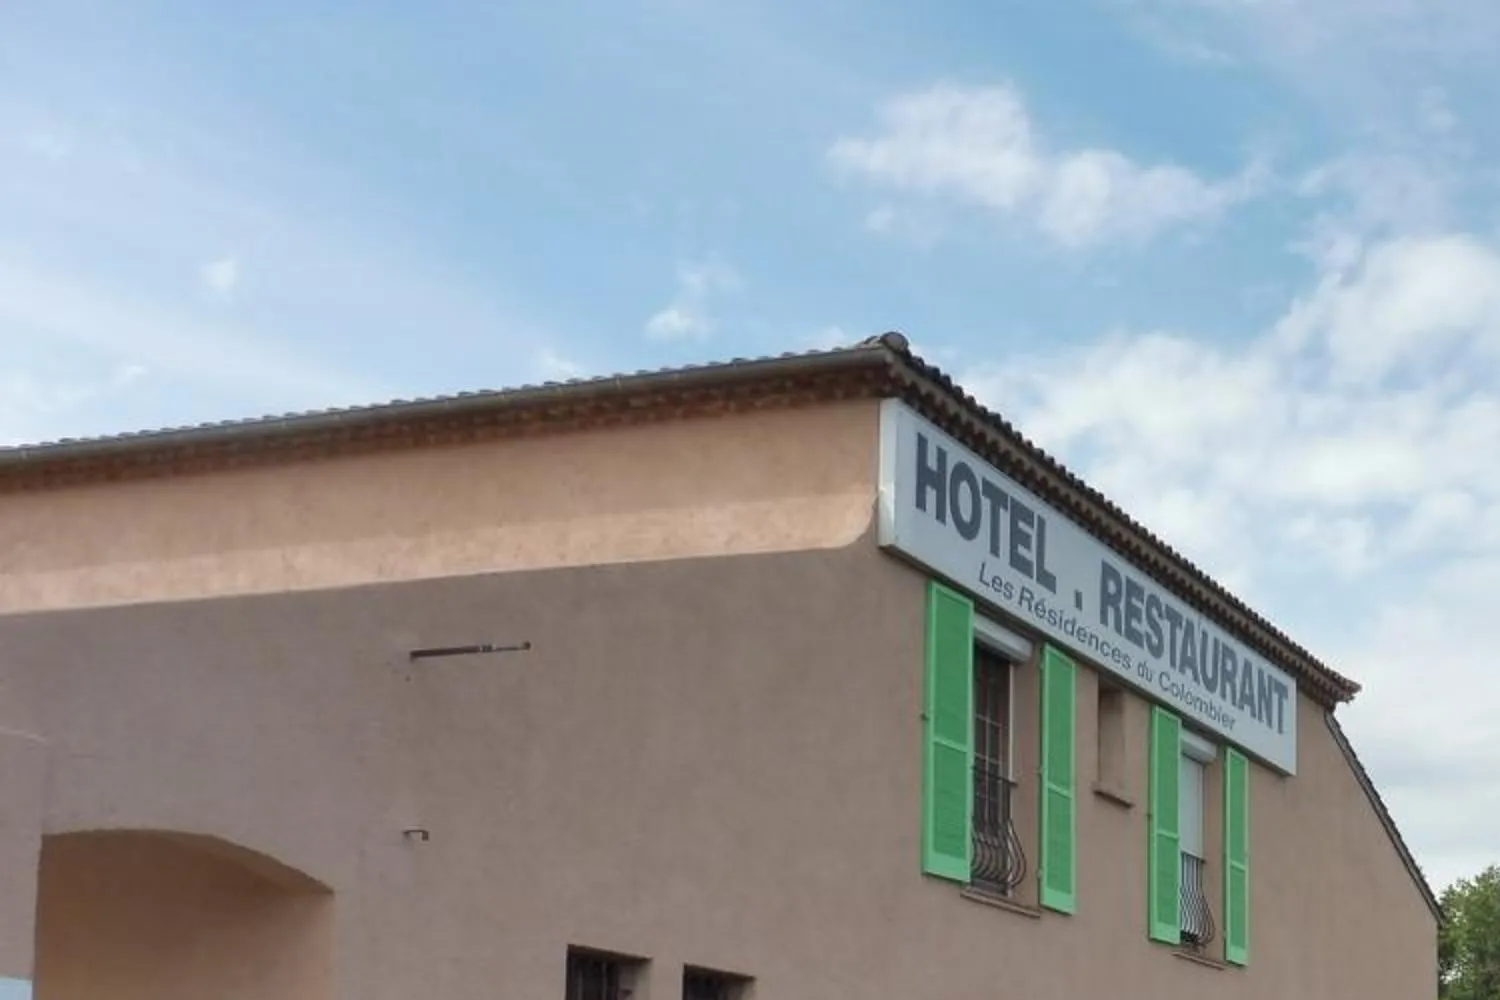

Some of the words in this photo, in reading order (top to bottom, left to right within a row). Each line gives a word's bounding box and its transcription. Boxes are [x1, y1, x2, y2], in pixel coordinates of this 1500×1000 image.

[915, 433, 1056, 594] HOTEL
[1100, 559, 1288, 734] RESTAURANT
[979, 563, 1013, 599] Les
[1018, 586, 1132, 670] Résidences
[1137, 657, 1153, 683] du
[1159, 671, 1236, 731] Colombier
